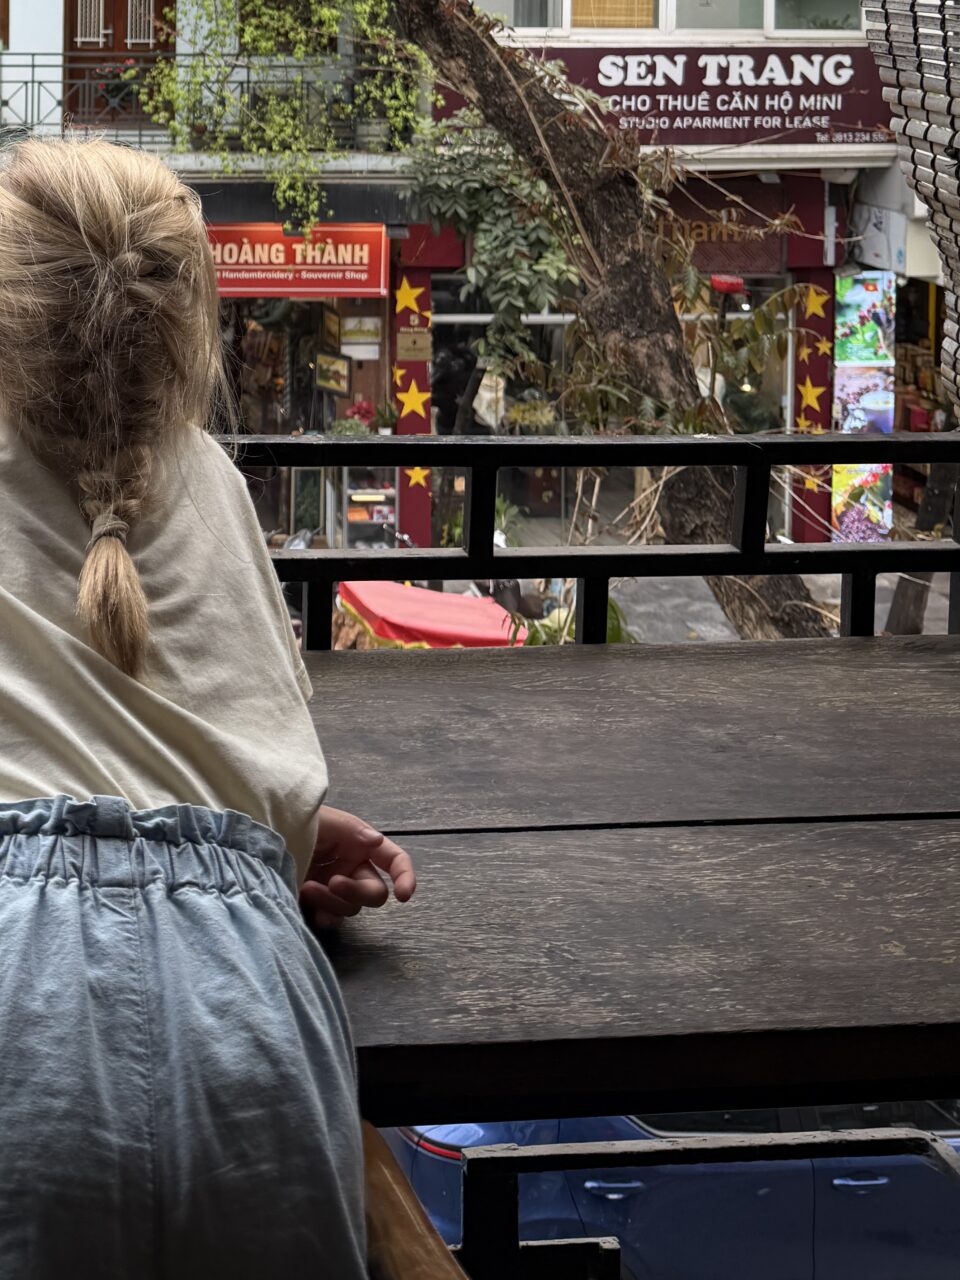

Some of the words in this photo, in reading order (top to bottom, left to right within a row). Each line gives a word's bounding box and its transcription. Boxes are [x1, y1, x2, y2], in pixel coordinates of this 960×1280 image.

[597, 53, 687, 87] SEN
[697, 53, 854, 87] TRANG
[608, 94, 651, 112] CHO
[655, 91, 711, 112] THUÊ
[716, 91, 759, 112] CĂN
[765, 91, 793, 115] HỘ
[799, 94, 842, 112] MINI
[672, 116, 751, 130] APARMENT
[753, 116, 782, 129] FOR
[212, 238, 285, 264] HOÀNG
[292, 238, 370, 265] THÀNH
[222, 270, 293, 281] Handembroidery
[344, 270, 368, 281] Shop
